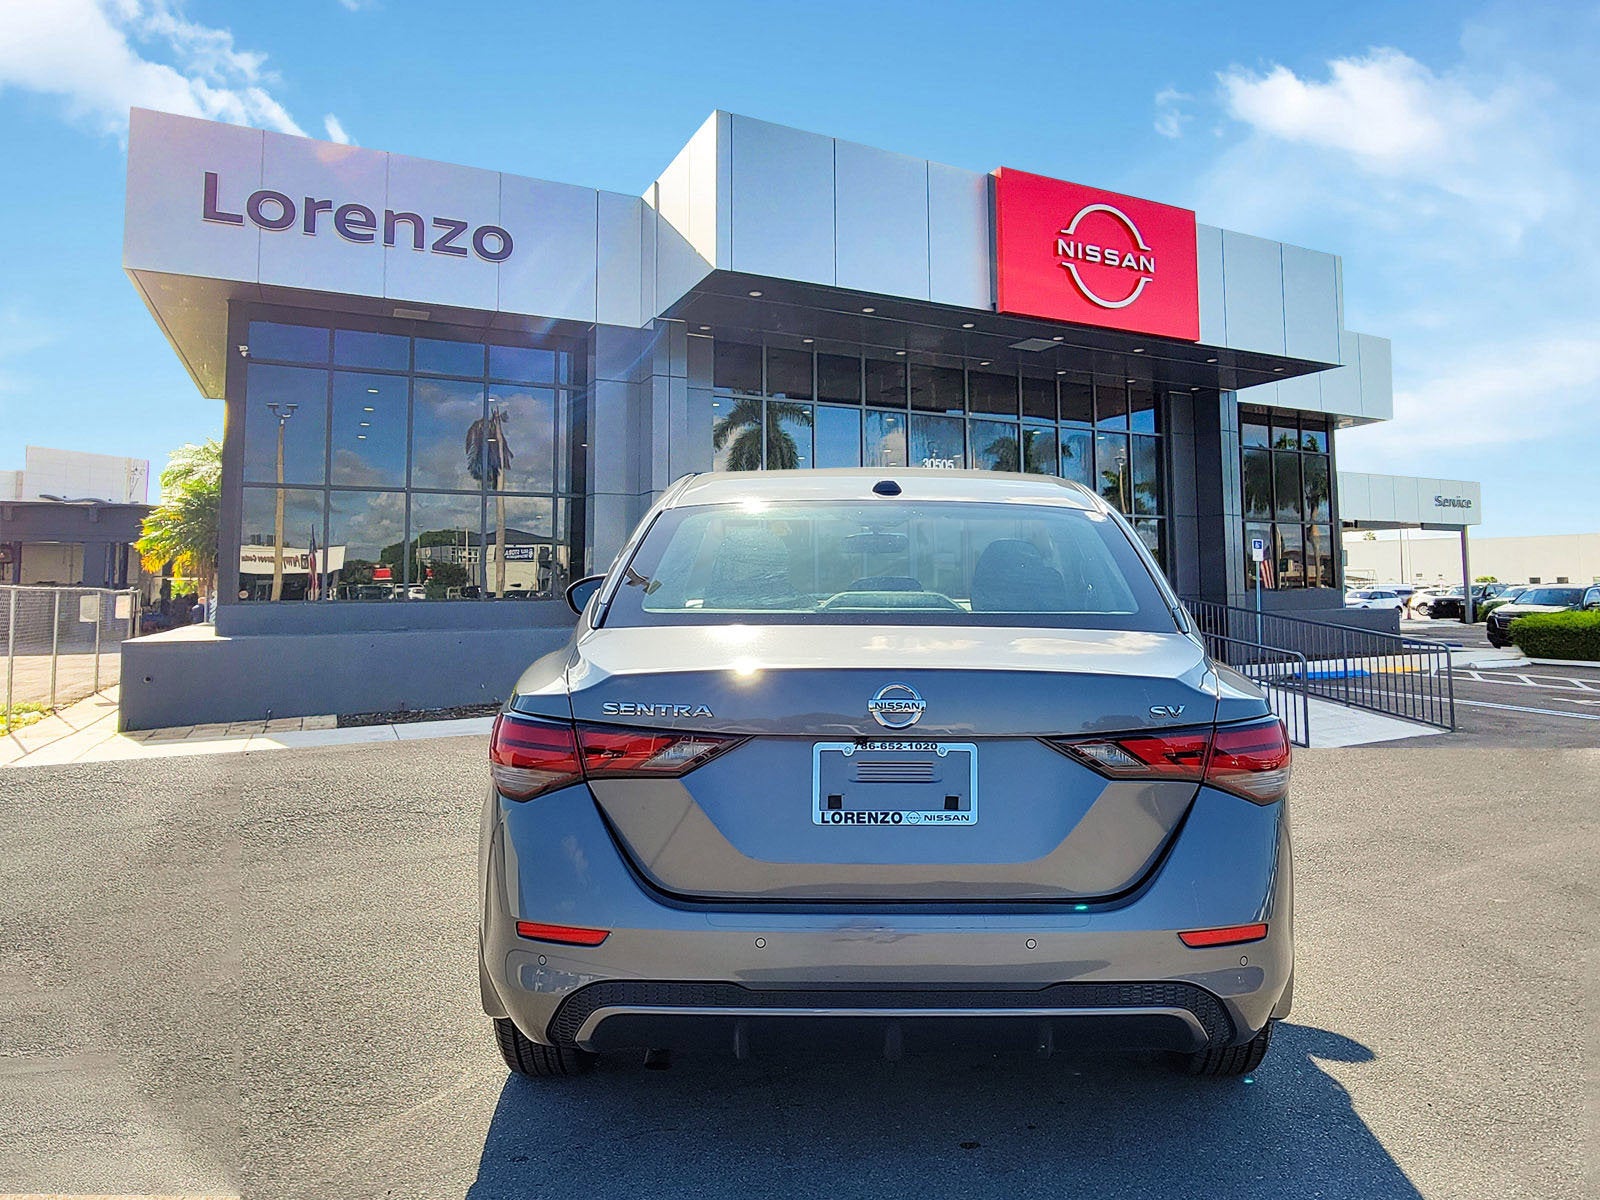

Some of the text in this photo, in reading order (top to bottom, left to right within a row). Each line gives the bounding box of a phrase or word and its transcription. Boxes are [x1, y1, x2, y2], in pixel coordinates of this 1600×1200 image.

[202, 171, 514, 262] Lorenzo
[1057, 238, 1155, 273] NISSAN
[922, 457, 954, 469] 30505
[1434, 495, 1472, 508] Service
[602, 702, 714, 718] SENTRA
[874, 701, 921, 711] NISSAN
[1149, 704, 1186, 719] SV
[820, 811, 903, 824] LORENZO
[923, 814, 970, 822] NISSAN
